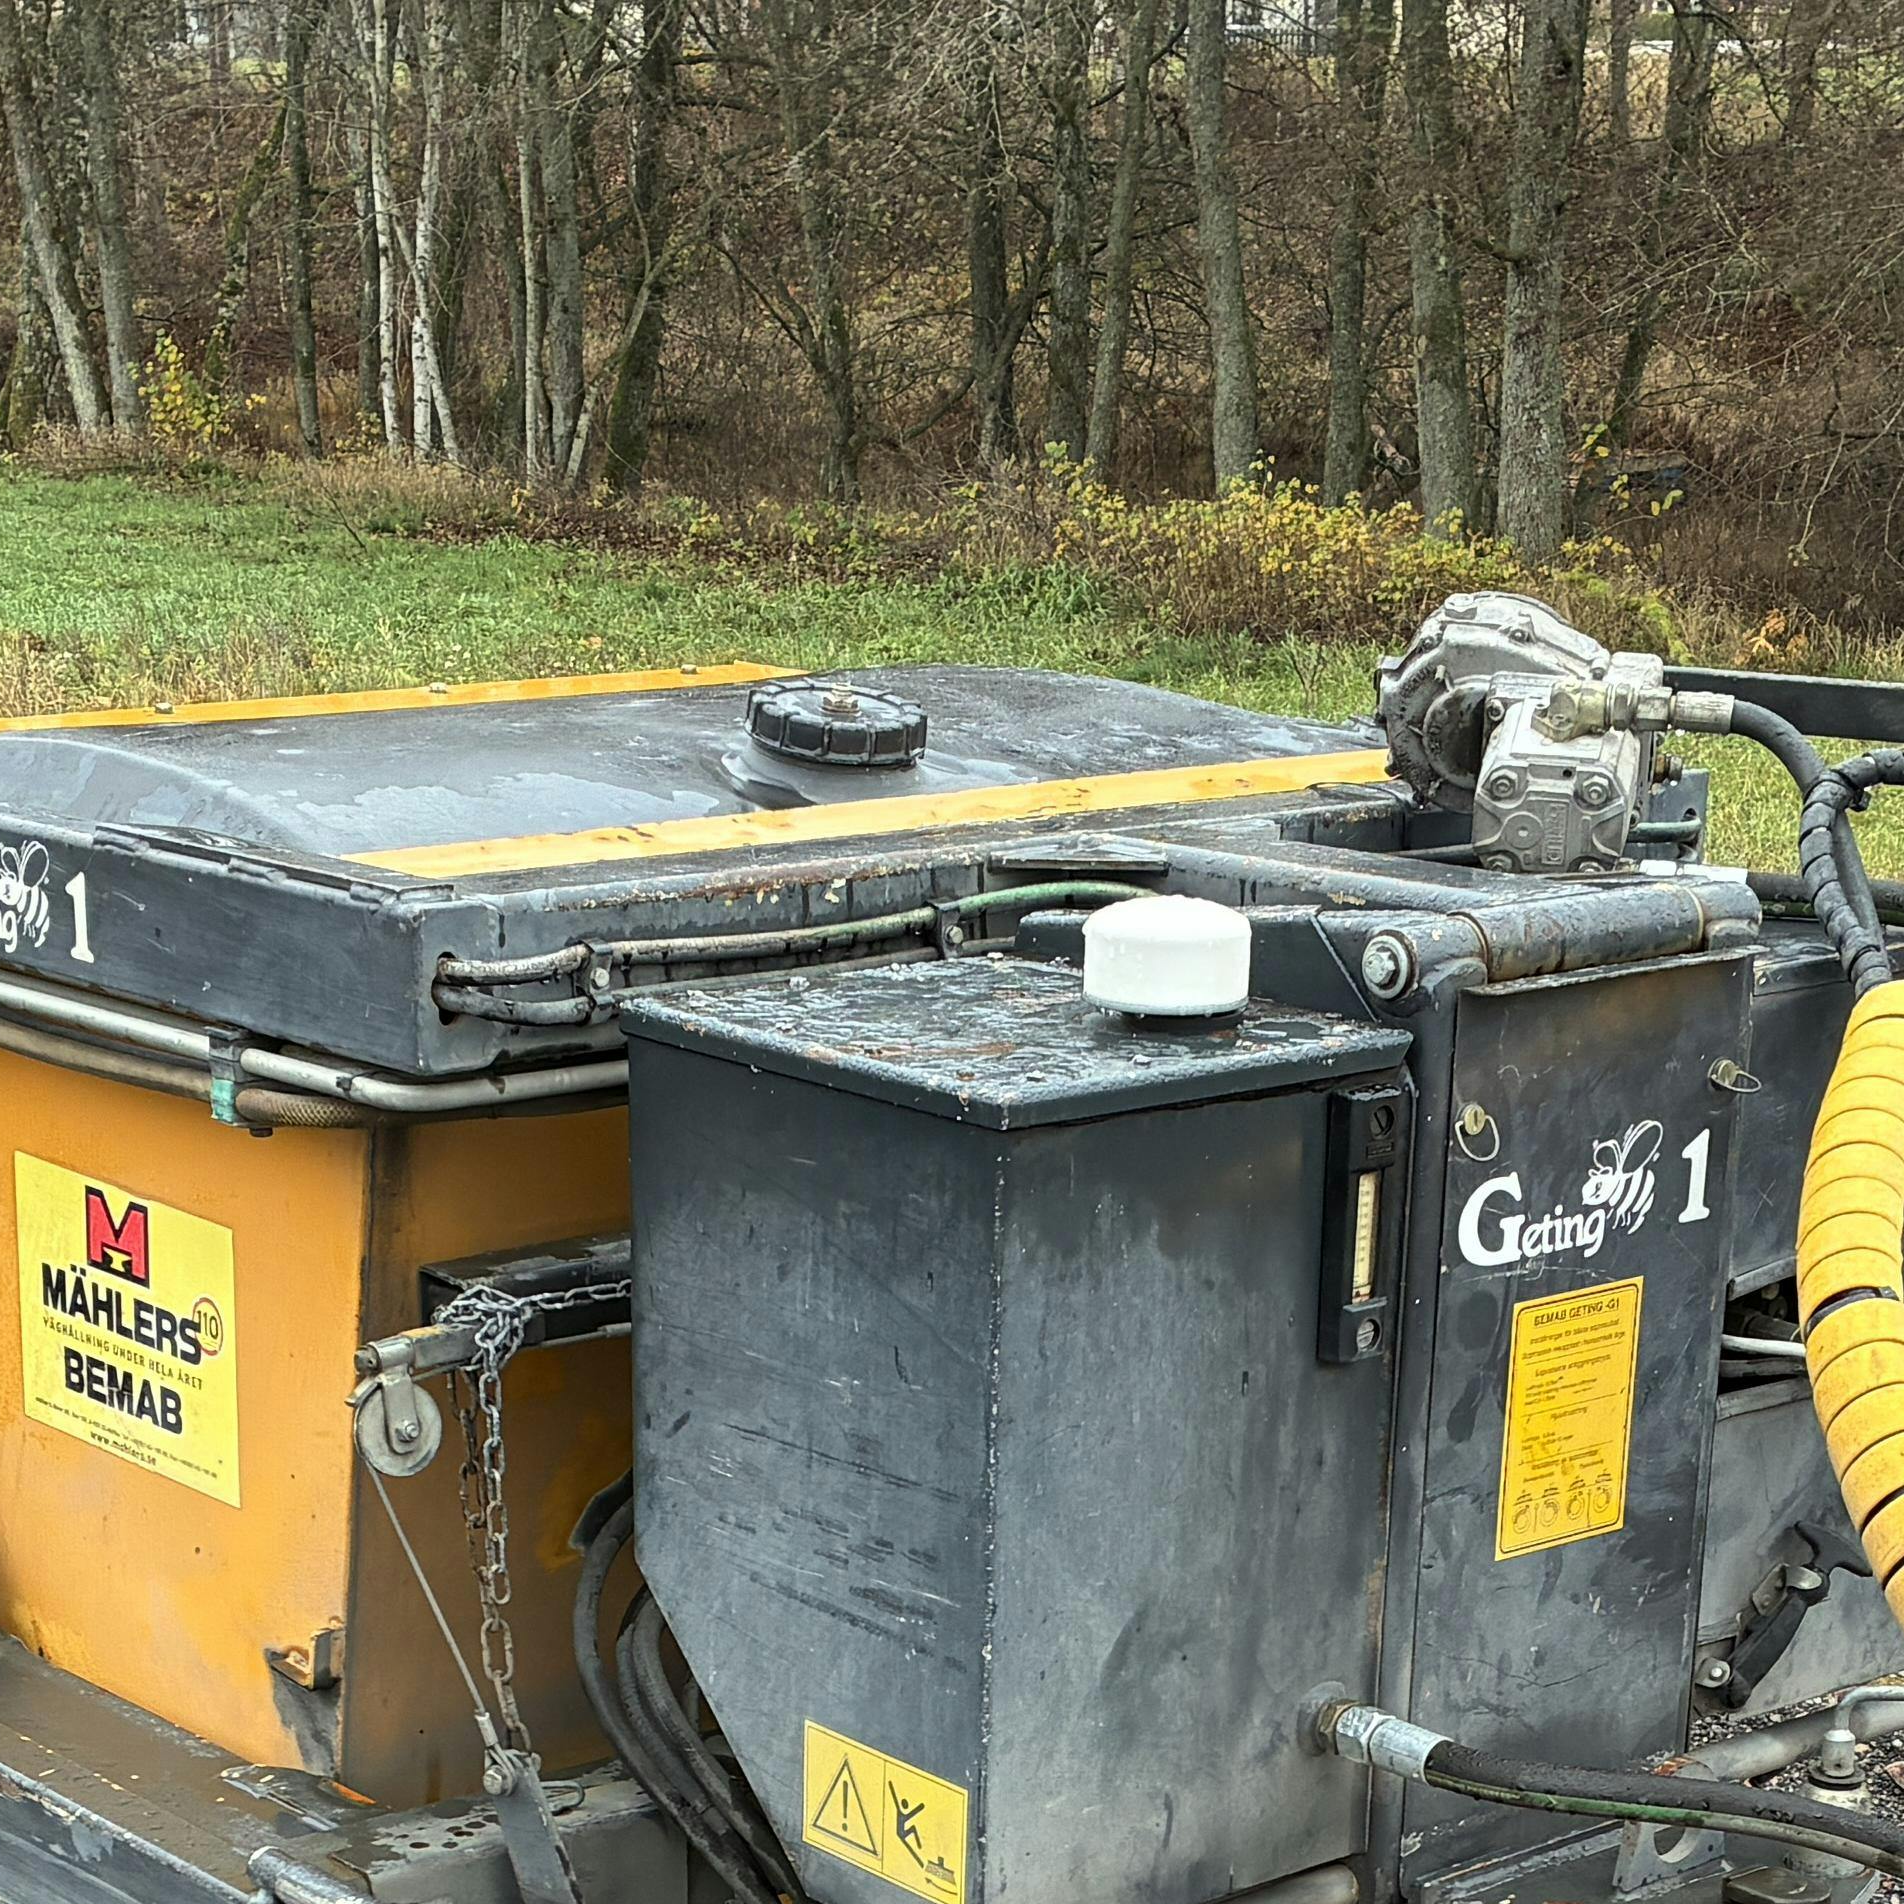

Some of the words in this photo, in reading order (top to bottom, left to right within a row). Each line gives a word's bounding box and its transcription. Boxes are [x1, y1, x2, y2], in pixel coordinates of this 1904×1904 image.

[64, 871, 95, 964] 1
[1458, 1171, 1607, 1267] Geting
[1678, 1128, 1711, 1224] 1
[41, 1262, 203, 1367] MÄHLERS
[112, 1343, 146, 1368] UNDER
[63, 1345, 184, 1436] BEMAB
